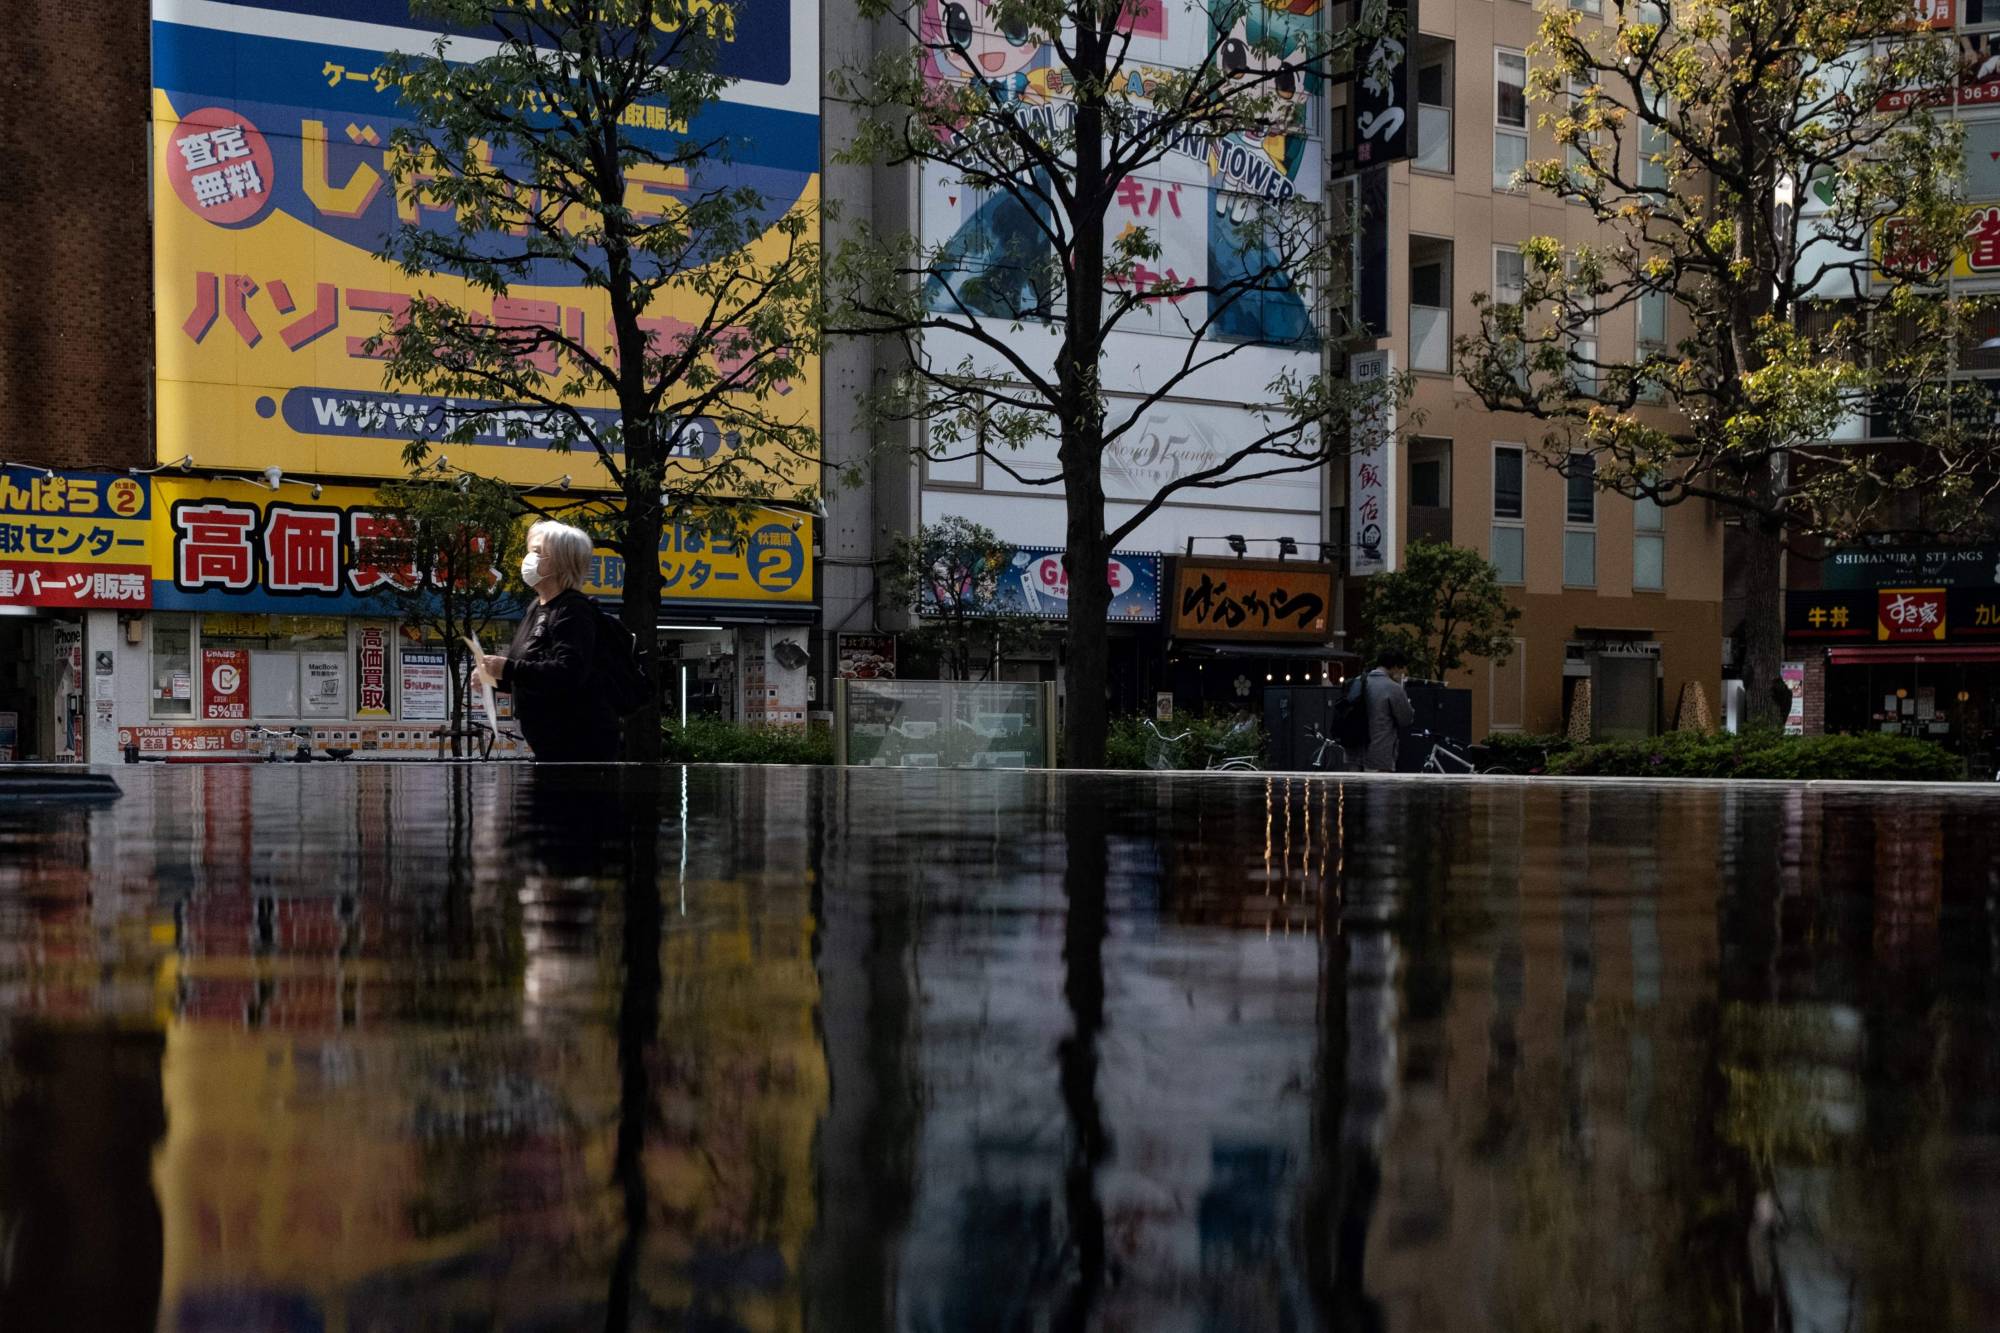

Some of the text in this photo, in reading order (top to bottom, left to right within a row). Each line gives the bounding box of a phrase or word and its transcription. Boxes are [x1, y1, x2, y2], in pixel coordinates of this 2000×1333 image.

[176, 125, 250, 172] 査定
[191, 160, 264, 208] 無料
[1359, 362, 1381, 376] 中国
[117, 490, 136, 513] 2
[758, 549, 793, 586] 2
[1808, 606, 1850, 628] 牛丼
[1886, 594, 1938, 626] すき家
[361, 627, 385, 710] 高価買取
